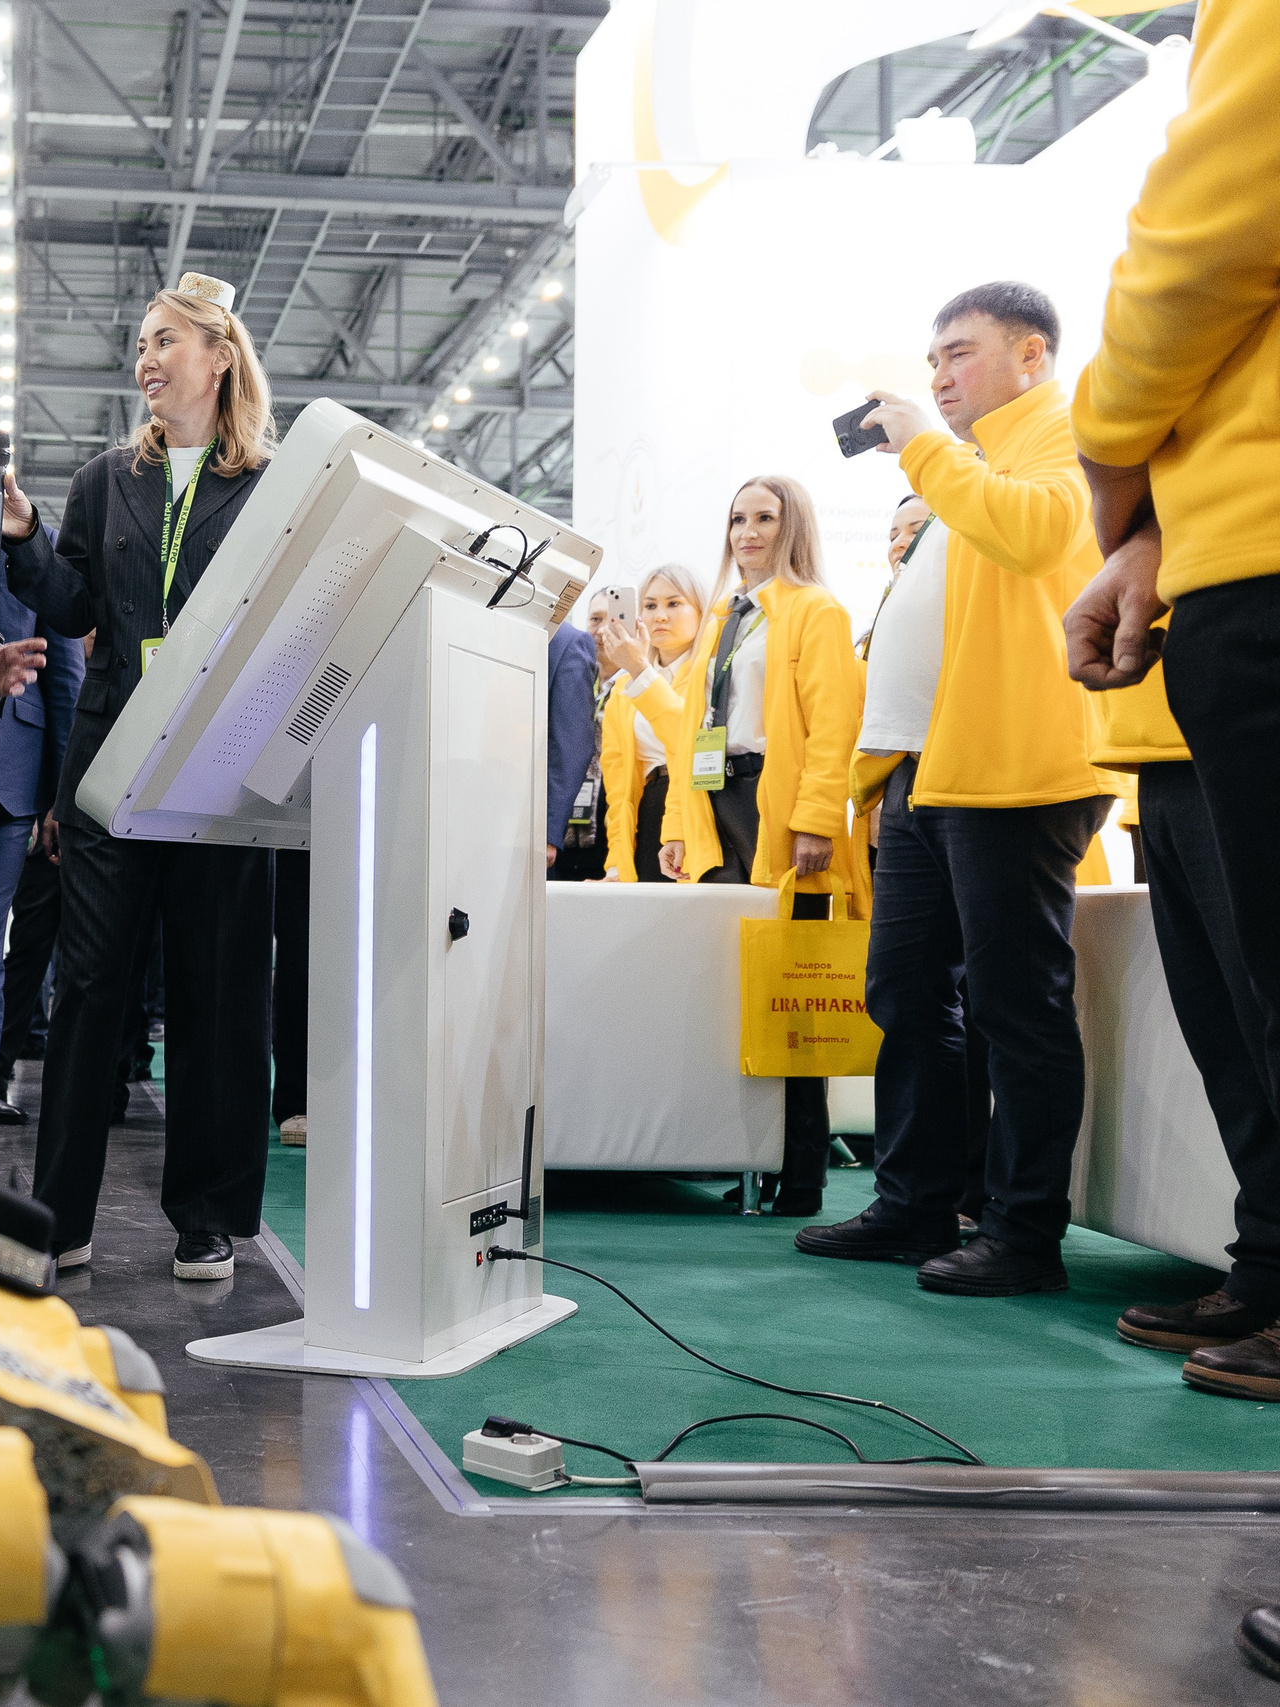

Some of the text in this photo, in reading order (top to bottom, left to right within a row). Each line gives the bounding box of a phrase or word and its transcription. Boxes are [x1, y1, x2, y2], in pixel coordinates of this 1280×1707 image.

[161, 501, 172, 555] КАЗАНЬ АГРО
[170, 511, 188, 563] КАЗАНЬ АГРО
[825, 973, 856, 981] время
[771, 997, 869, 1014] LIRA PHARM
